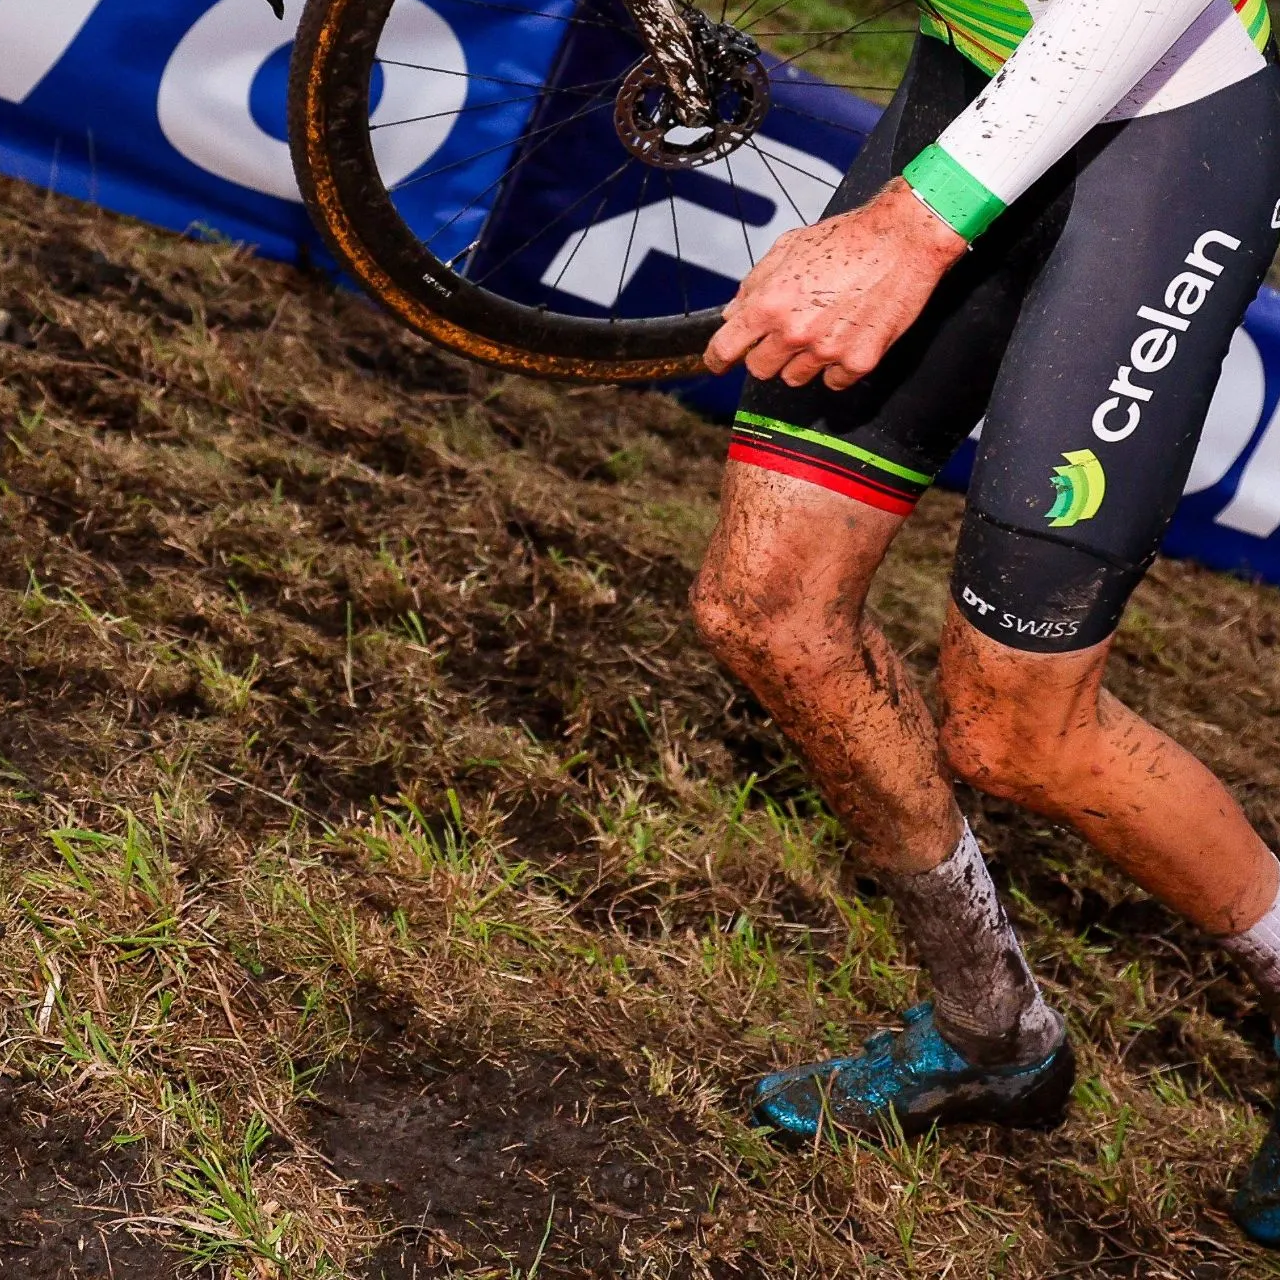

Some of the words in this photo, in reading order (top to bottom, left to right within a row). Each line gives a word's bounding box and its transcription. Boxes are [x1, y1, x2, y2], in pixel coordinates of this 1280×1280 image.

[1091, 228, 1242, 443] crelan
[962, 586, 996, 616] DT
[999, 610, 1081, 639] SWISS
